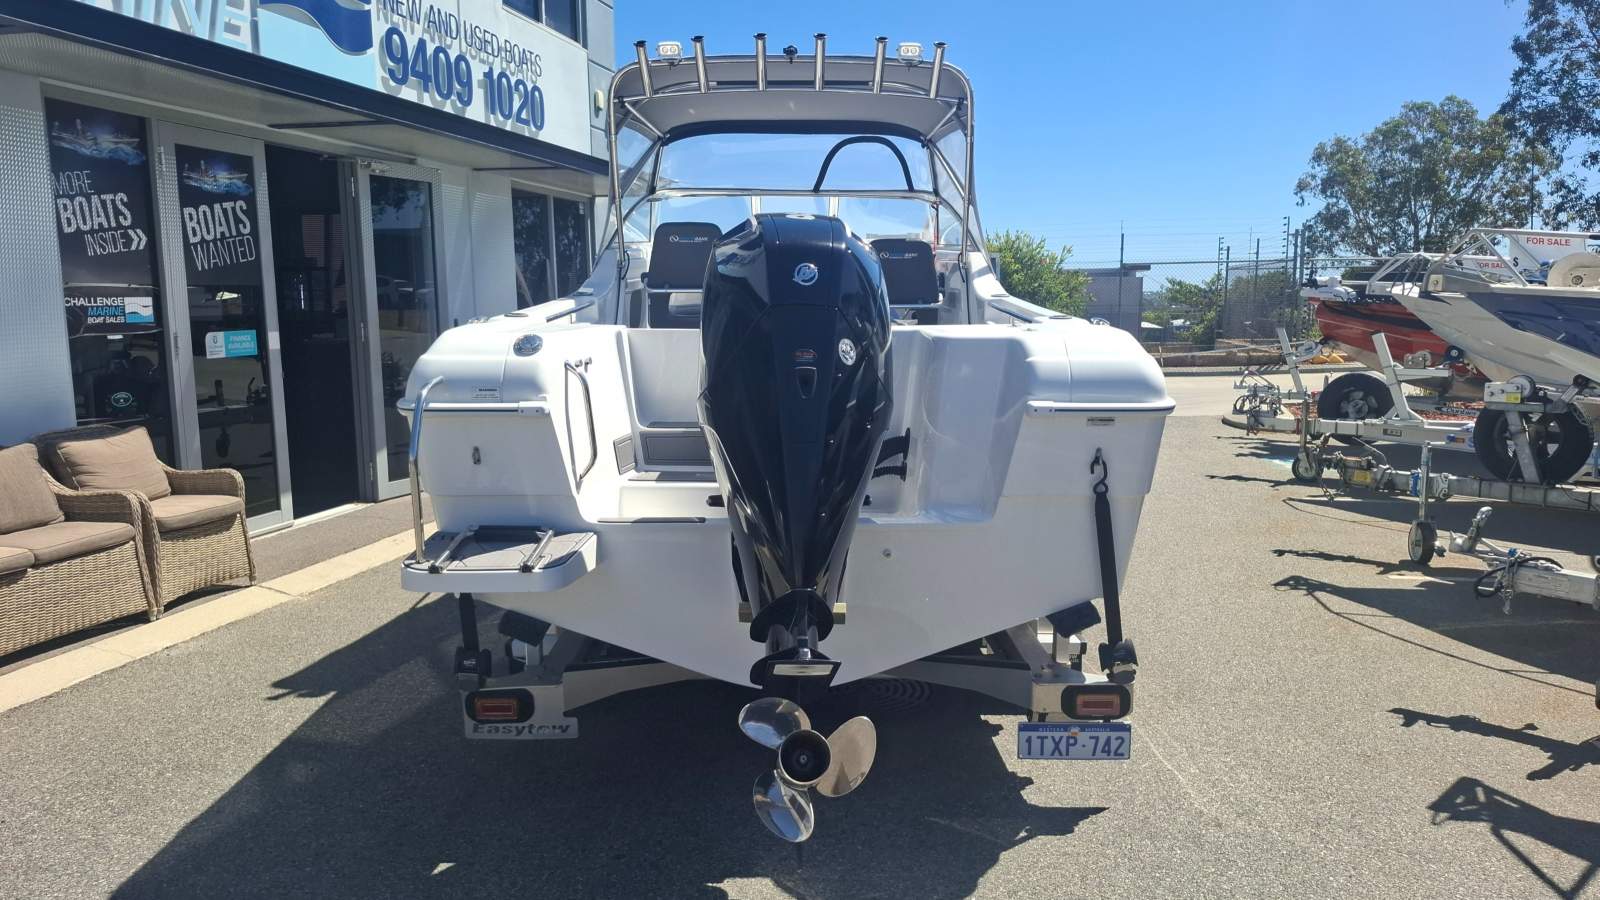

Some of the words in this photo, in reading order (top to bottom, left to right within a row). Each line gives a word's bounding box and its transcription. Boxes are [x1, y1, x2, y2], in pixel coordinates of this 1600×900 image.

[383, 0, 422, 24] NEW
[427, 5, 459, 40] AND
[463, 21, 501, 58] USED
[504, 40, 543, 77] BOATS
[385, 26, 473, 108] 9409
[483, 66, 545, 132] 1020
[52, 170, 94, 195] MORE
[56, 192, 132, 234] BOATS
[182, 200, 251, 244] BOATS
[84, 229, 129, 257] INSIDE
[190, 235, 256, 272] WANTED
[1526, 236, 1545, 245] FOR
[1547, 238, 1571, 246] SALE
[64, 297, 125, 307] CHALLENGE
[87, 306, 125, 316] MARINE
[87, 316, 105, 324] BOAT
